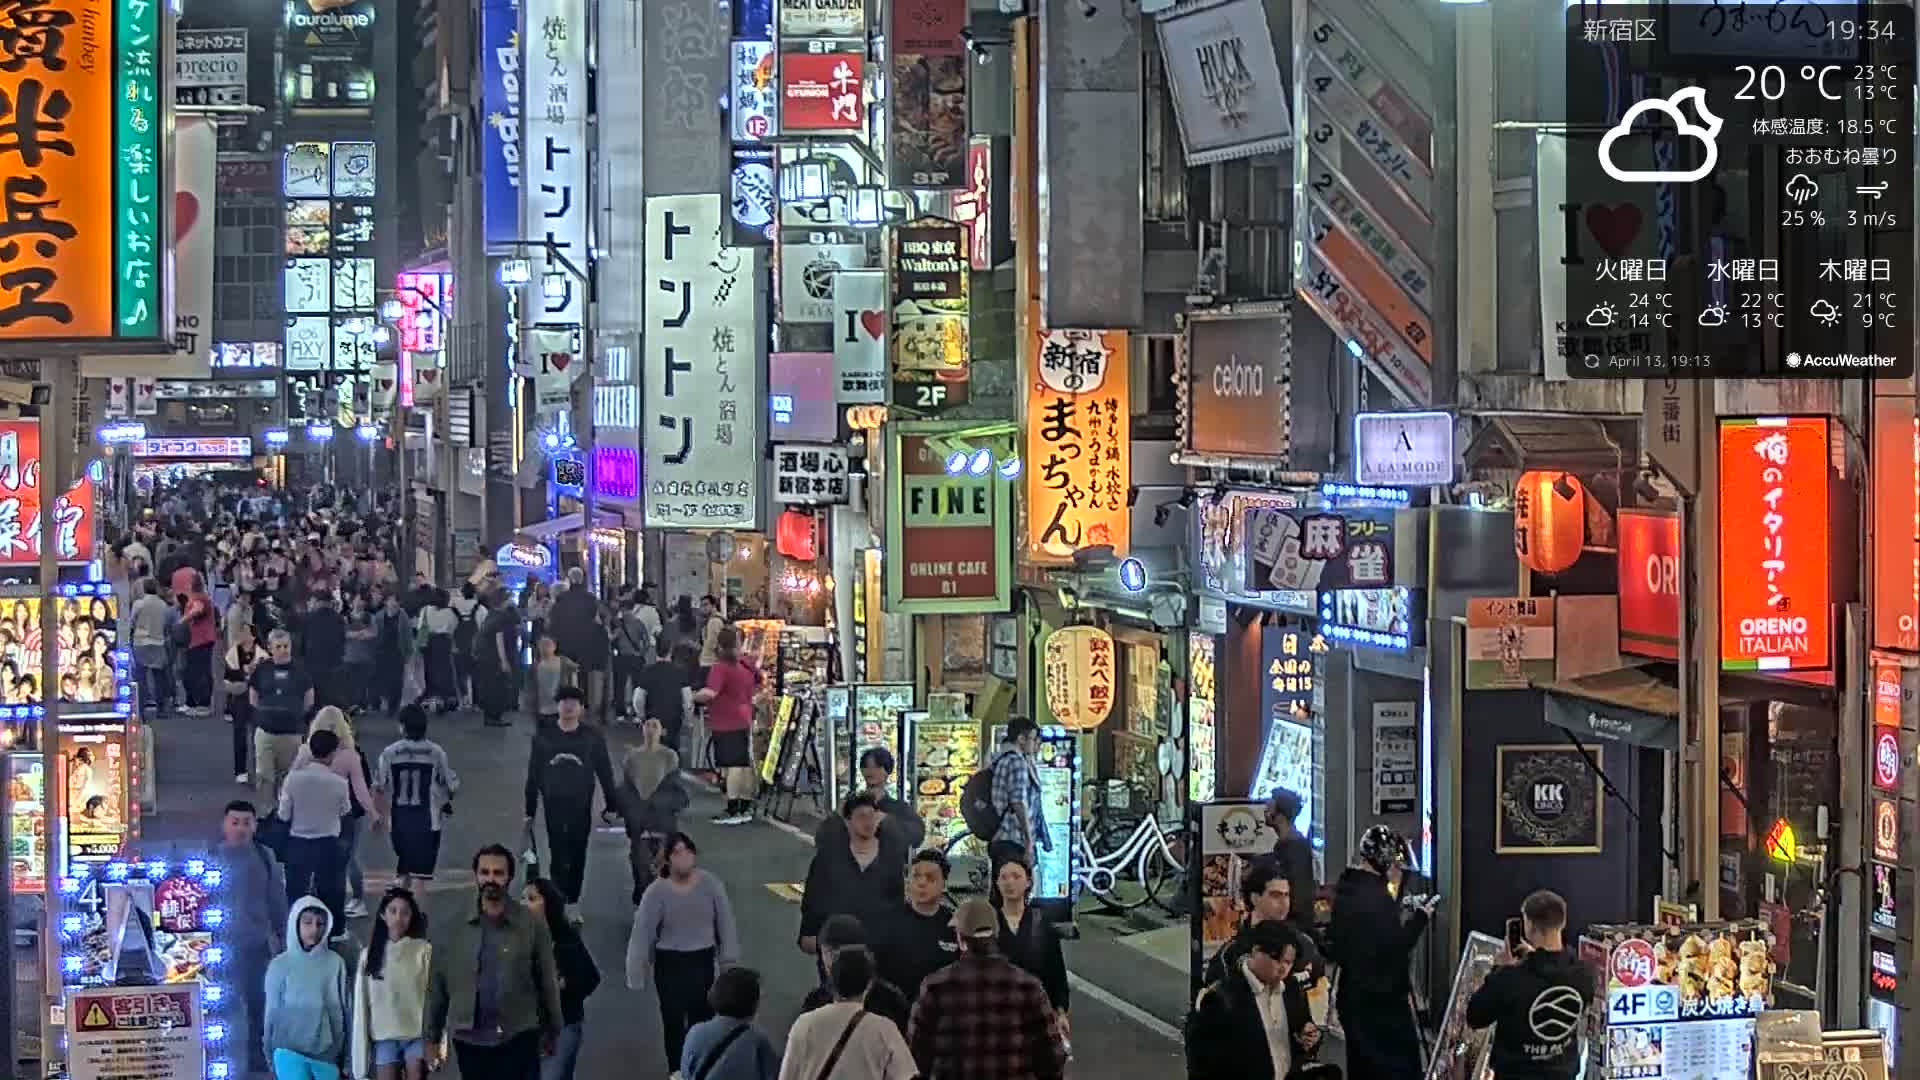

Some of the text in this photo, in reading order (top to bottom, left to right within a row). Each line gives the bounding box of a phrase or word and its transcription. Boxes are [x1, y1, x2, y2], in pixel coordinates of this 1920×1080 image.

[1314, 23, 1334, 43] 5
[829, 60, 859, 122] 牛門
[1314, 76, 1333, 93] 4
[1314, 124, 1334, 143] 3
[1313, 173, 1333, 193] 2
[845, 310, 859, 342] I
[659, 211, 692, 464] トントン
[916, 386, 947, 407] 2F
[780, 451, 844, 473] 酒場心
[1040, 396, 1085, 547] まっちゃん
[779, 476, 844, 495] 新宿本店
[911, 487, 985, 515] FINE
[1350, 521, 1389, 535] フリー
[1754, 431, 1789, 606] 俺のイタリアン
[1740, 616, 1808, 635] ORENO
[1739, 635, 1808, 653] ITALIAN
[397, 768, 422, 806] 11
[1534, 783, 1564, 801] KK
[1612, 993, 1646, 1015] 4F
